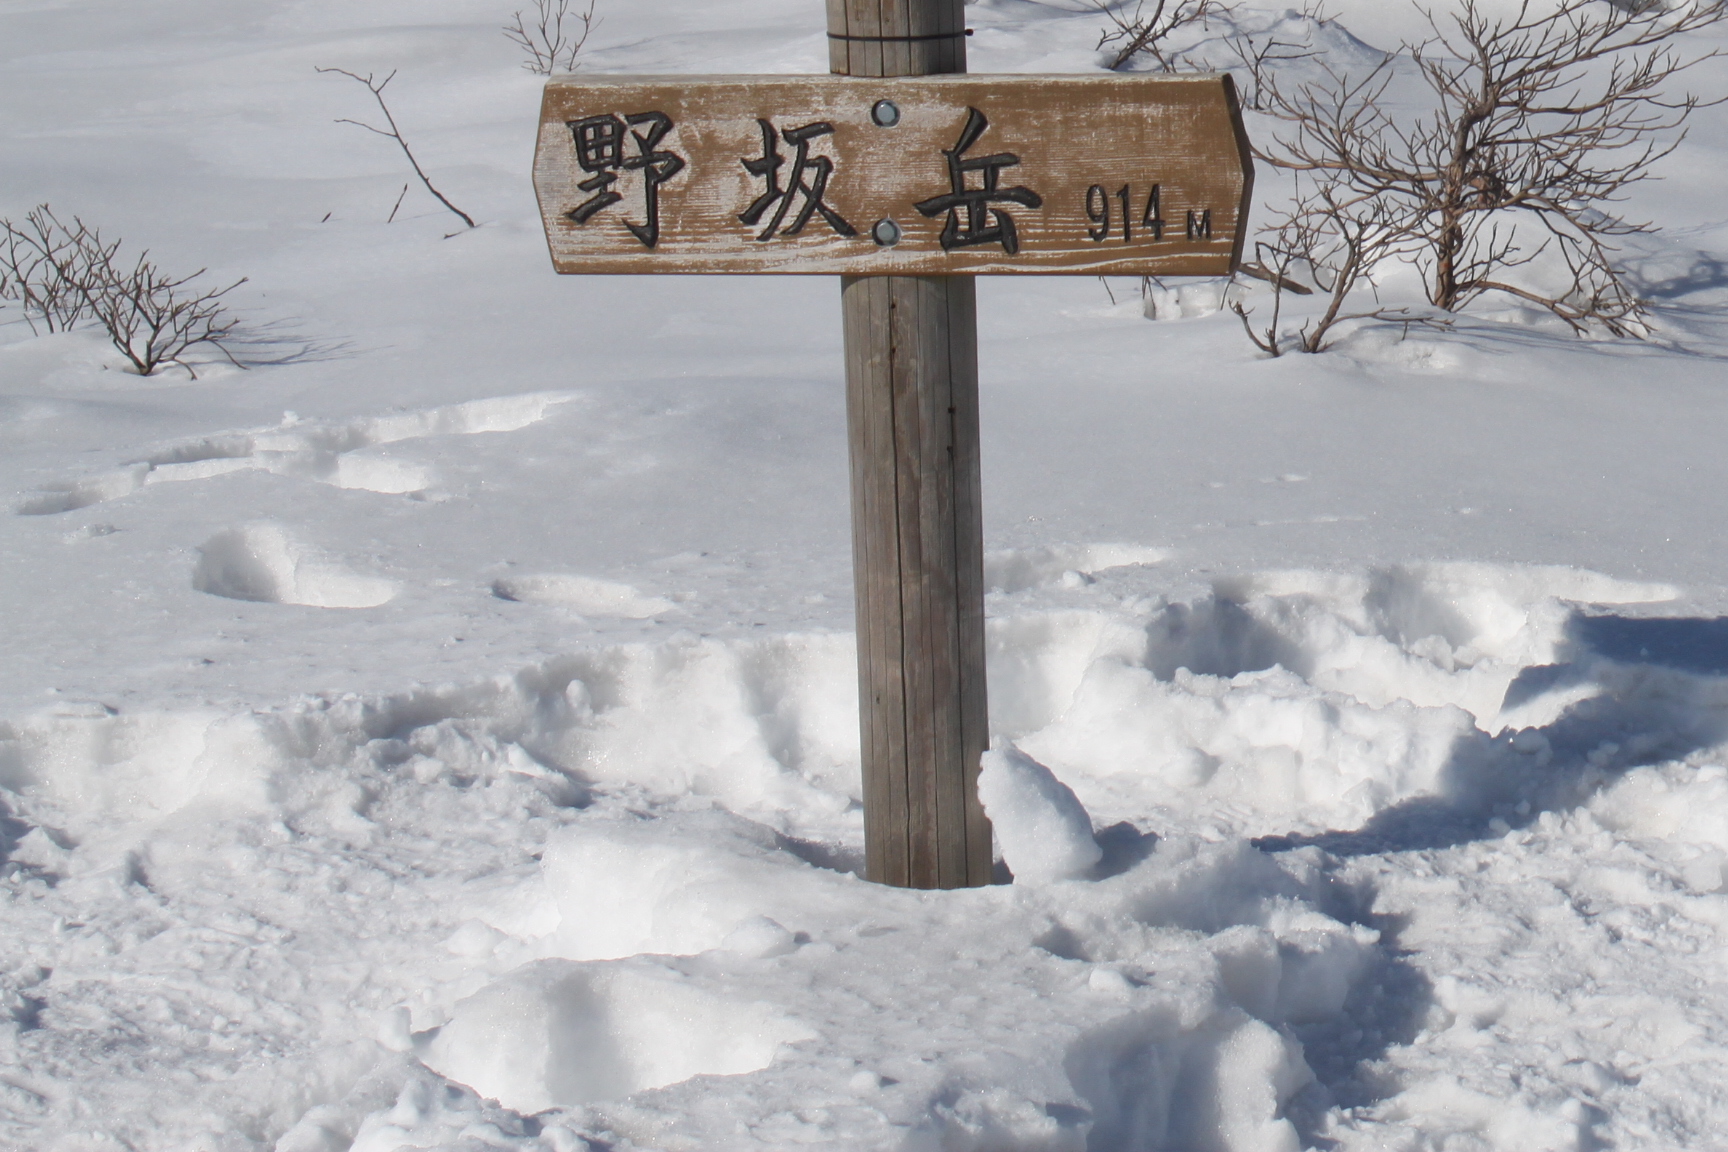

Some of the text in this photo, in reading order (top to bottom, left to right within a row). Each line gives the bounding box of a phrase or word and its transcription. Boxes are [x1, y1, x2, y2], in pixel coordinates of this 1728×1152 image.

[563, 105, 1043, 255] 野坂岳
[1085, 183, 1166, 243] 914
